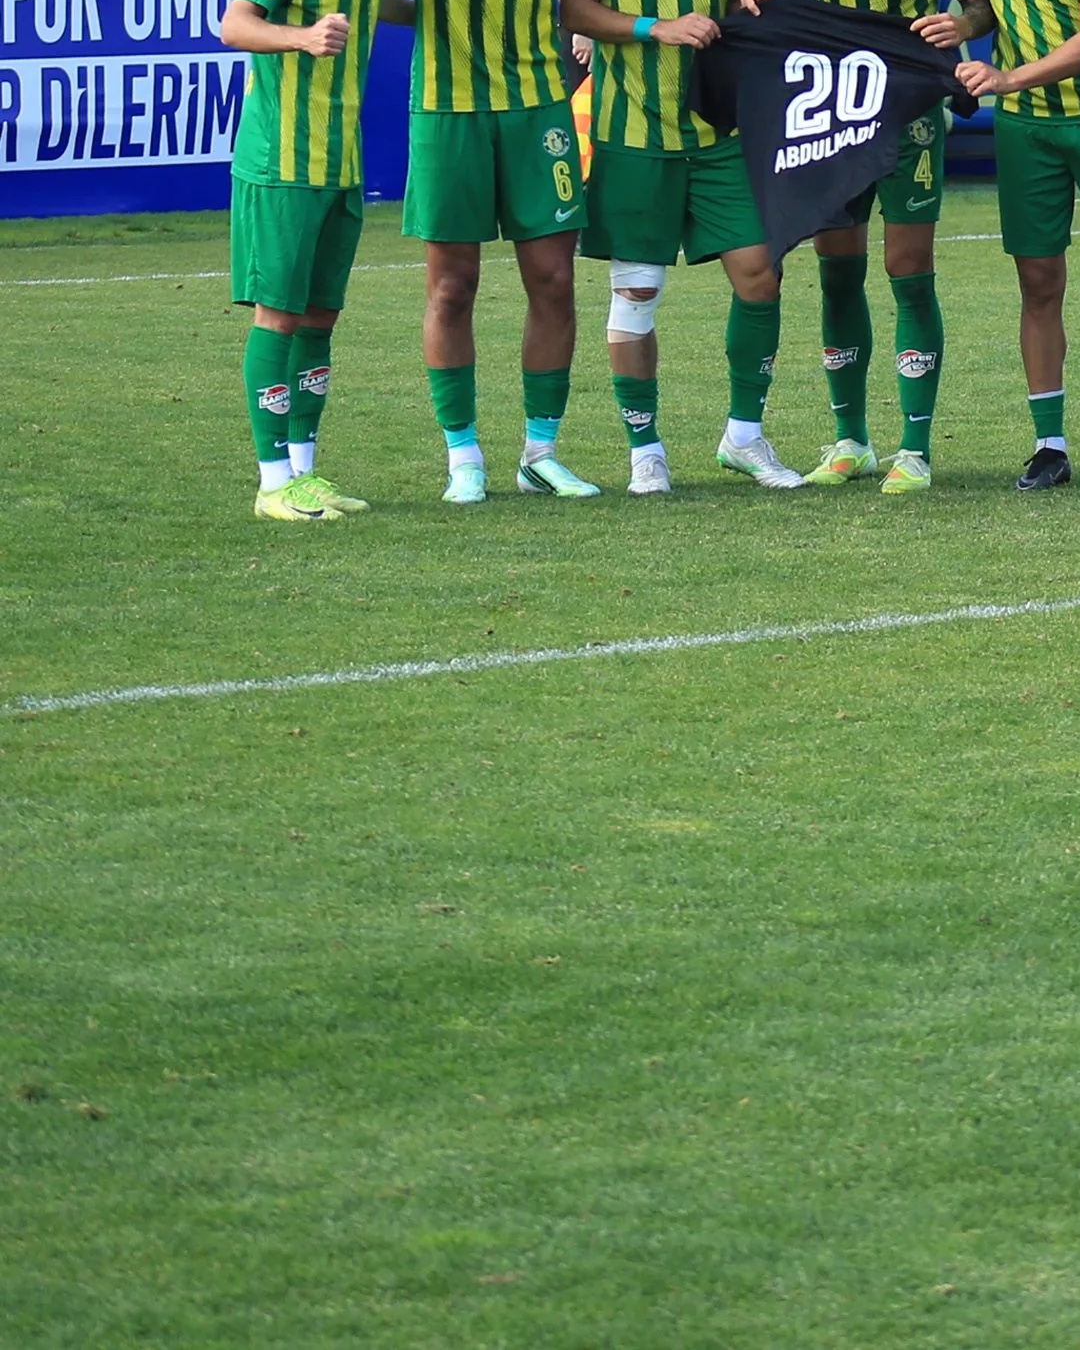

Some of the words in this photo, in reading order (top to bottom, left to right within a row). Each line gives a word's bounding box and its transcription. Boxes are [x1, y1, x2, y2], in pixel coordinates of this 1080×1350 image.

[36, 60, 245, 163] DİLERİM
[784, 50, 887, 139] 20
[553, 160, 573, 202] 6
[914, 150, 933, 190] 4
